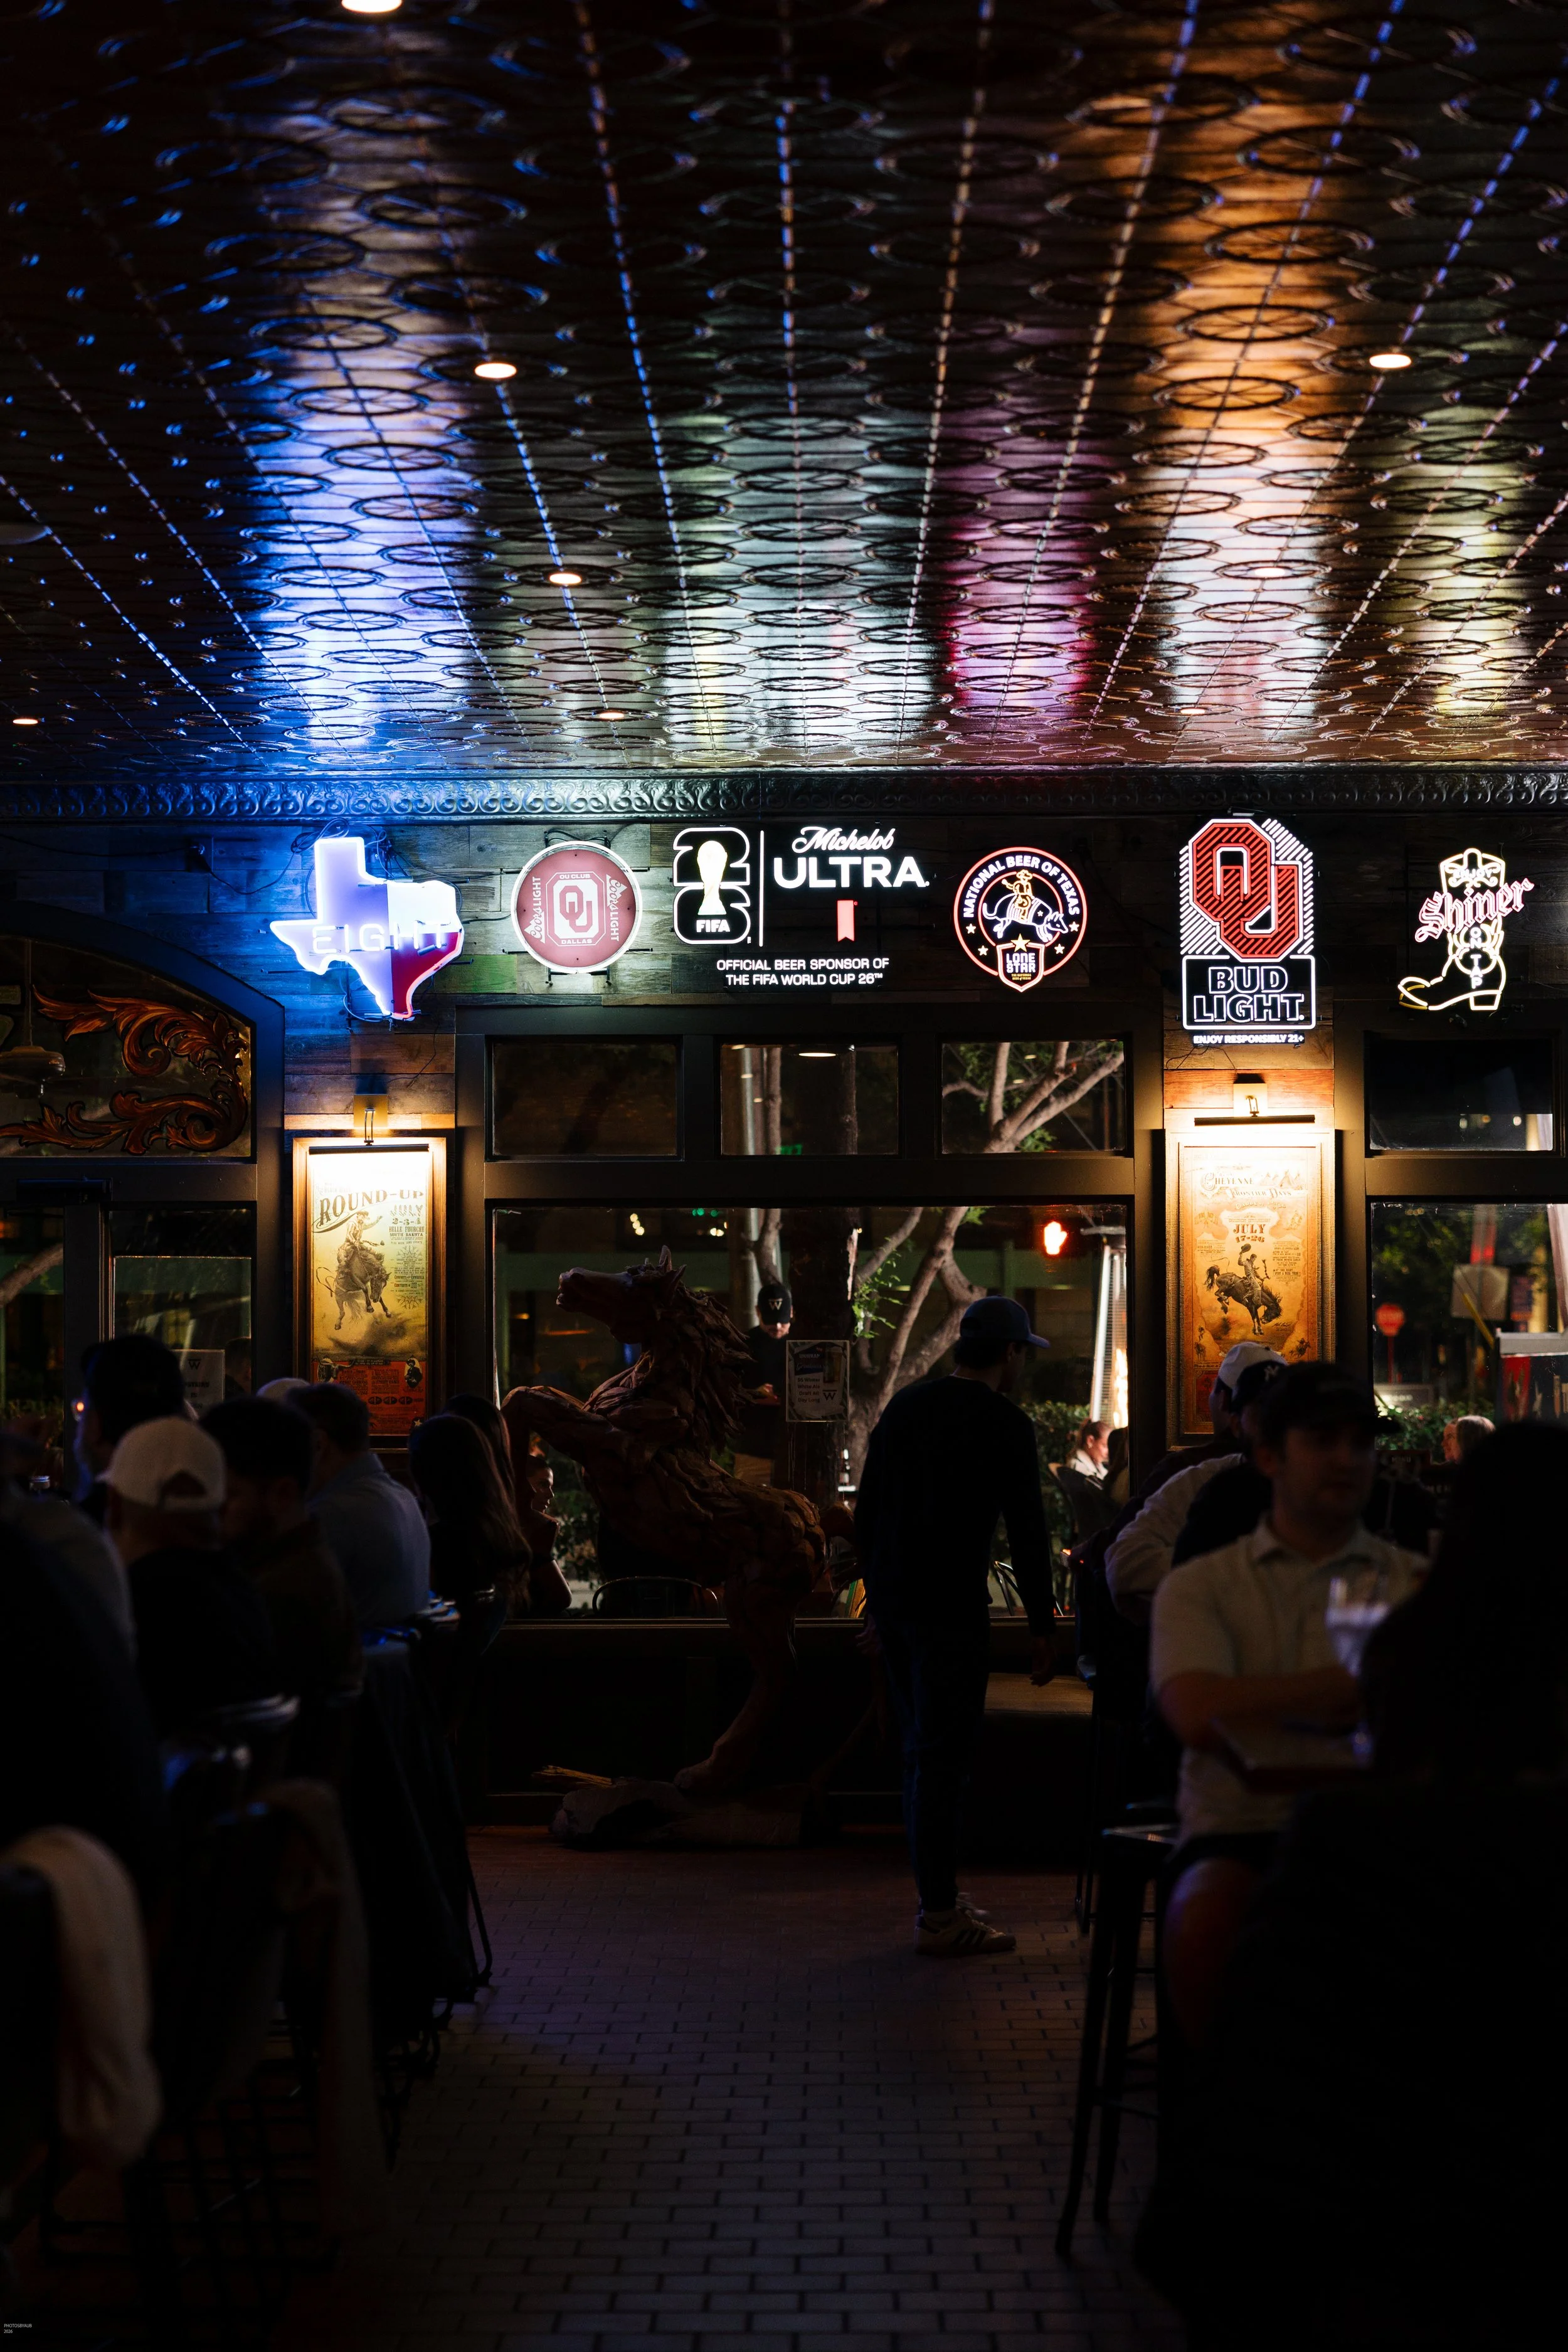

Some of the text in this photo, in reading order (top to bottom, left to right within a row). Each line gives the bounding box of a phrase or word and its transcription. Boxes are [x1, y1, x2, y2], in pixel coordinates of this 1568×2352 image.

[792, 826, 896, 853] Michelob
[1453, 869, 1493, 878] ENJOY
[963, 855, 1080, 918] NATIONAL BEER OF TEXAS
[531, 877, 544, 939] Coors LIGHT
[609, 879, 622, 942] Coors LIGHT
[1414, 877, 1535, 943] Shiner
[696, 919, 731, 933] FIFA
[313, 919, 451, 953] EIGHT
[717, 958, 889, 971] OFFICIAL BEER SPONSOR OF
[1006, 953, 1036, 963] LONE
[1470, 926, 1483, 989] ON TAP
[1006, 963, 1036, 973] STAR
[726, 974, 750, 985] THE
[753, 974, 778, 985] FIFA
[781, 974, 827, 985] WORLD
[829, 973, 856, 985] CUP
[1209, 966, 1288, 994] BUD
[1193, 1034, 1305, 1044] ENJOY RESPONSIBLY 21+
[319, 1189, 425, 1227] ROUND-UP
[389, 1204, 423, 1217] JULY
[1233, 1224, 1266, 1234] JULY
[768, 1298, 783, 1310] W
